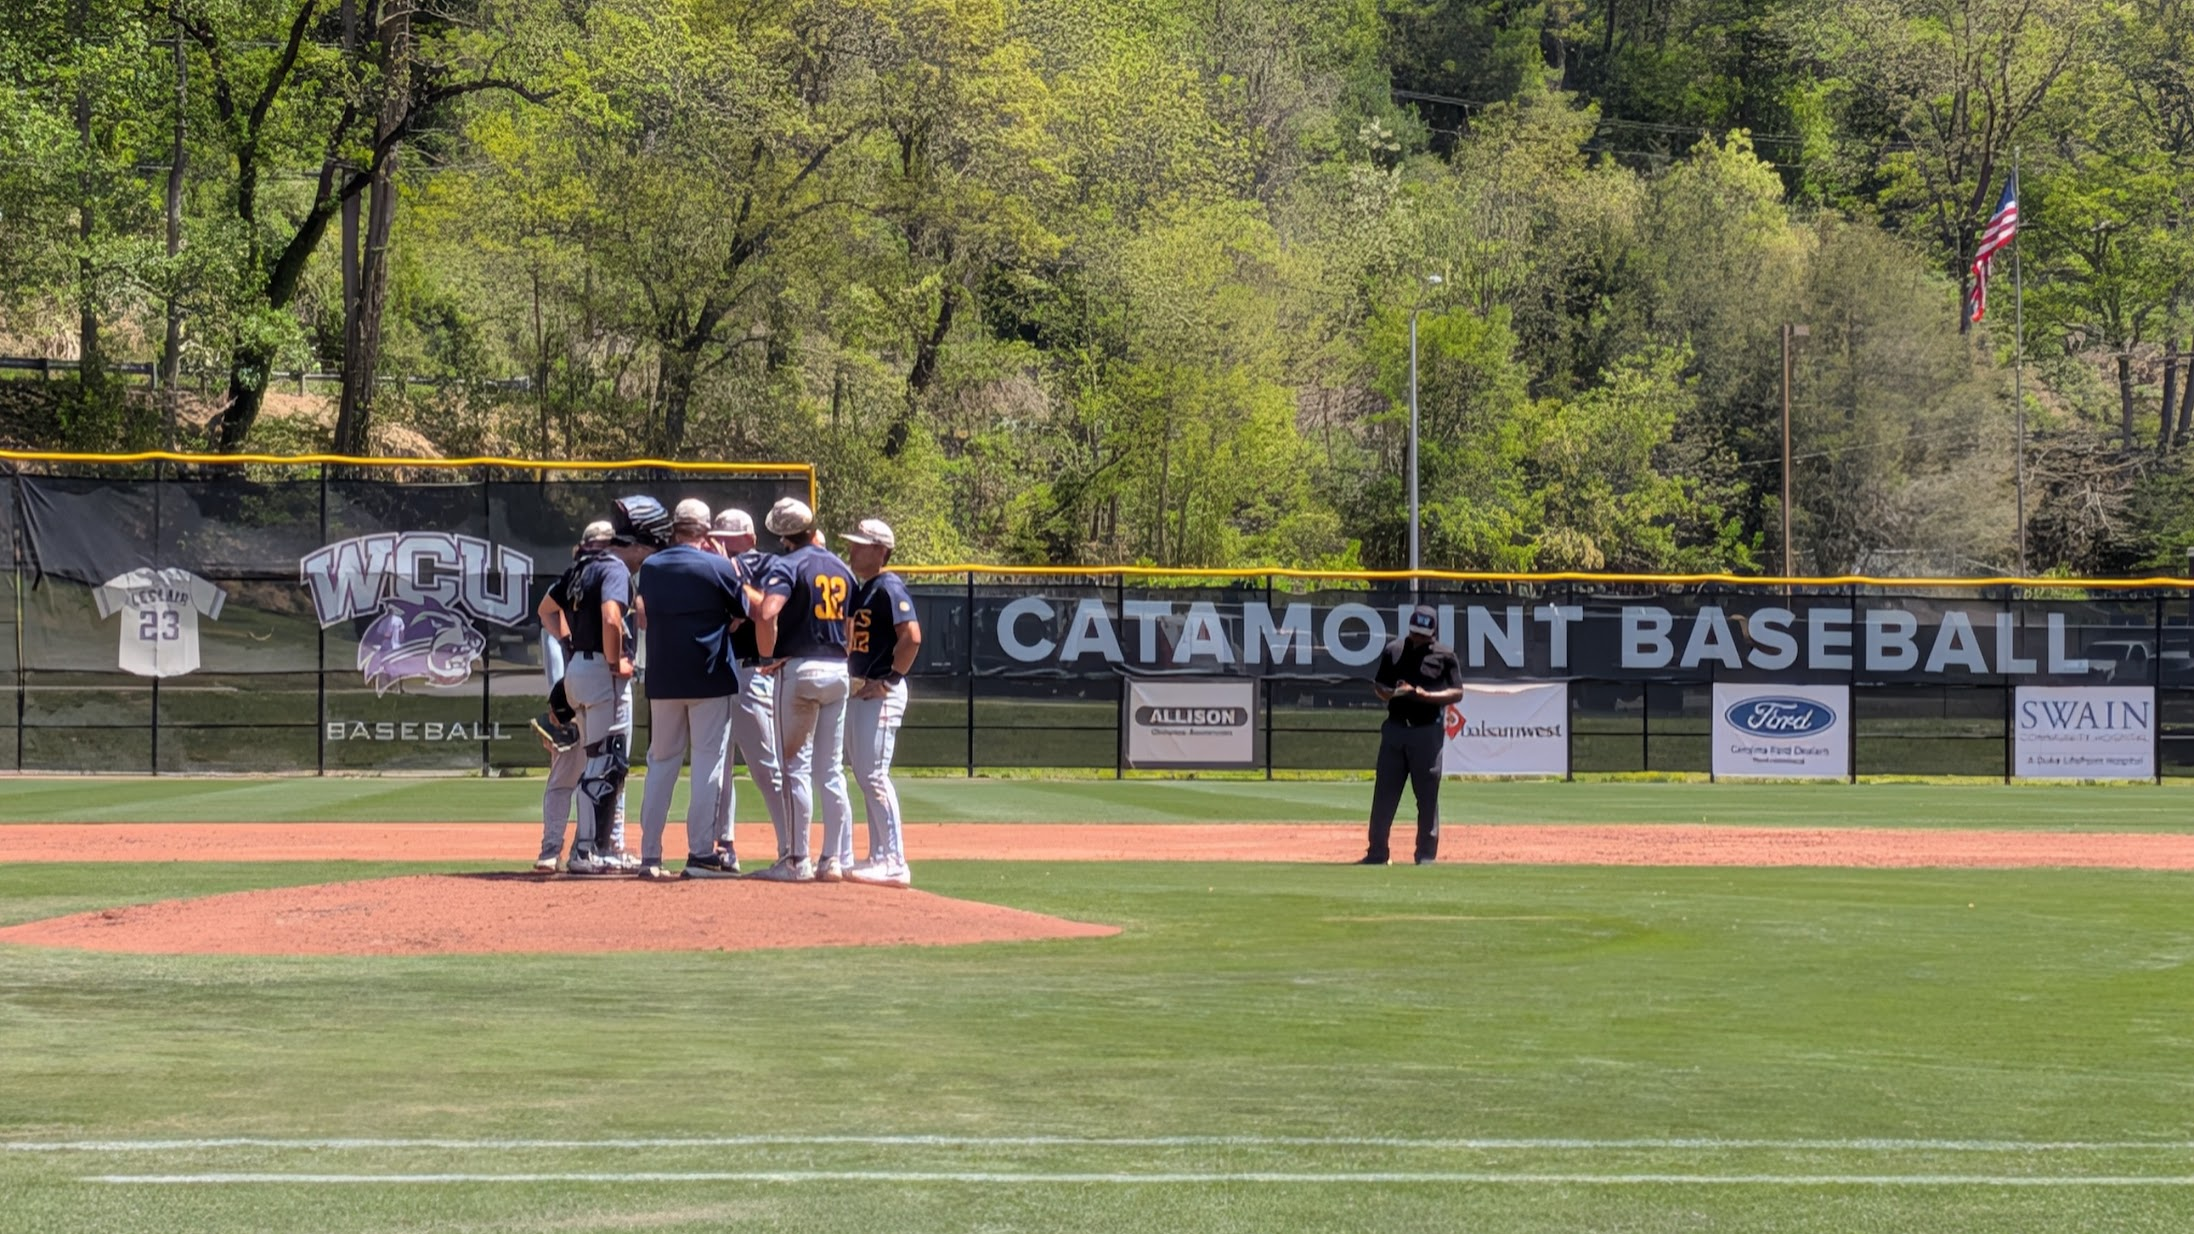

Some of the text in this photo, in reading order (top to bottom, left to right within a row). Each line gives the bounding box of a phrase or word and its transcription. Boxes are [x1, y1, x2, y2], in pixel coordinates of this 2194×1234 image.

[301, 531, 534, 629] WCU
[814, 573, 848, 621] 32
[139, 610, 179, 641] 23
[1621, 605, 2089, 675] BASEBALL
[1150, 709, 1236, 725] ALLISON
[1747, 702, 1814, 730] Ford
[2021, 700, 2150, 730] SWAIN
[327, 722, 512, 741] BASEBALL
